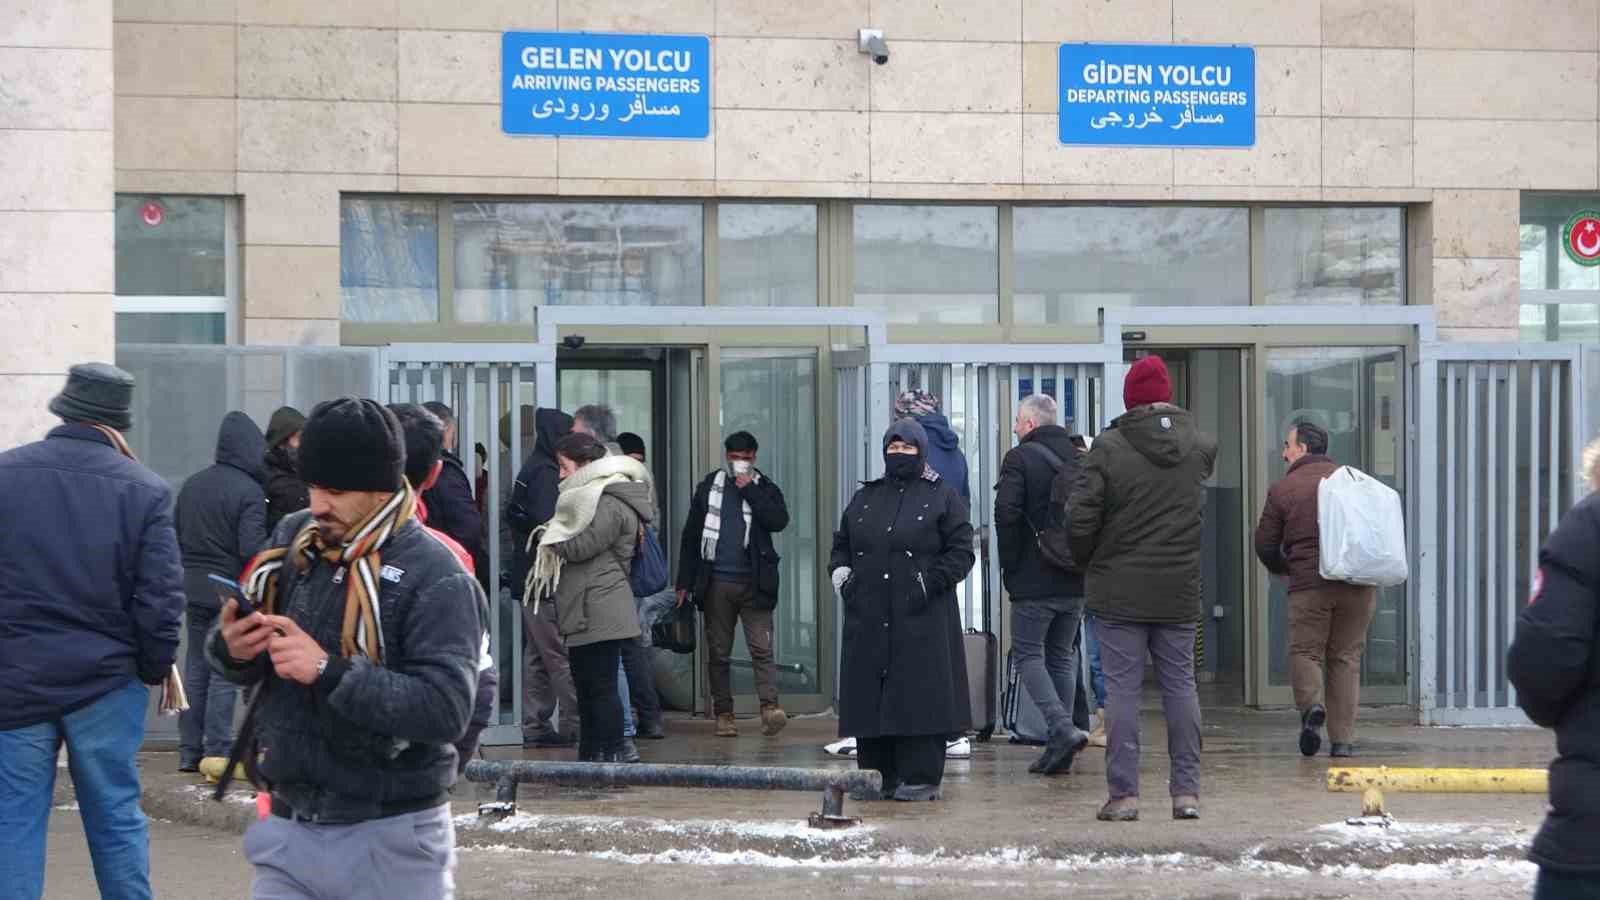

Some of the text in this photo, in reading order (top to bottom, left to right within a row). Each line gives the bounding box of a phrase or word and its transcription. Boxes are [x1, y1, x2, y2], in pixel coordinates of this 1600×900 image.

[521, 47, 691, 72] GELEN YOLCU
[512, 74, 701, 93] ARRIVING PASSENGERS
[1084, 61, 1232, 86] GİDEN YOLCU
[531, 94, 681, 122] مسافر ورودی
[1067, 89, 1247, 105] DEPARTING PASSENGERS
[1090, 105, 1225, 130] مسافر خروجی
